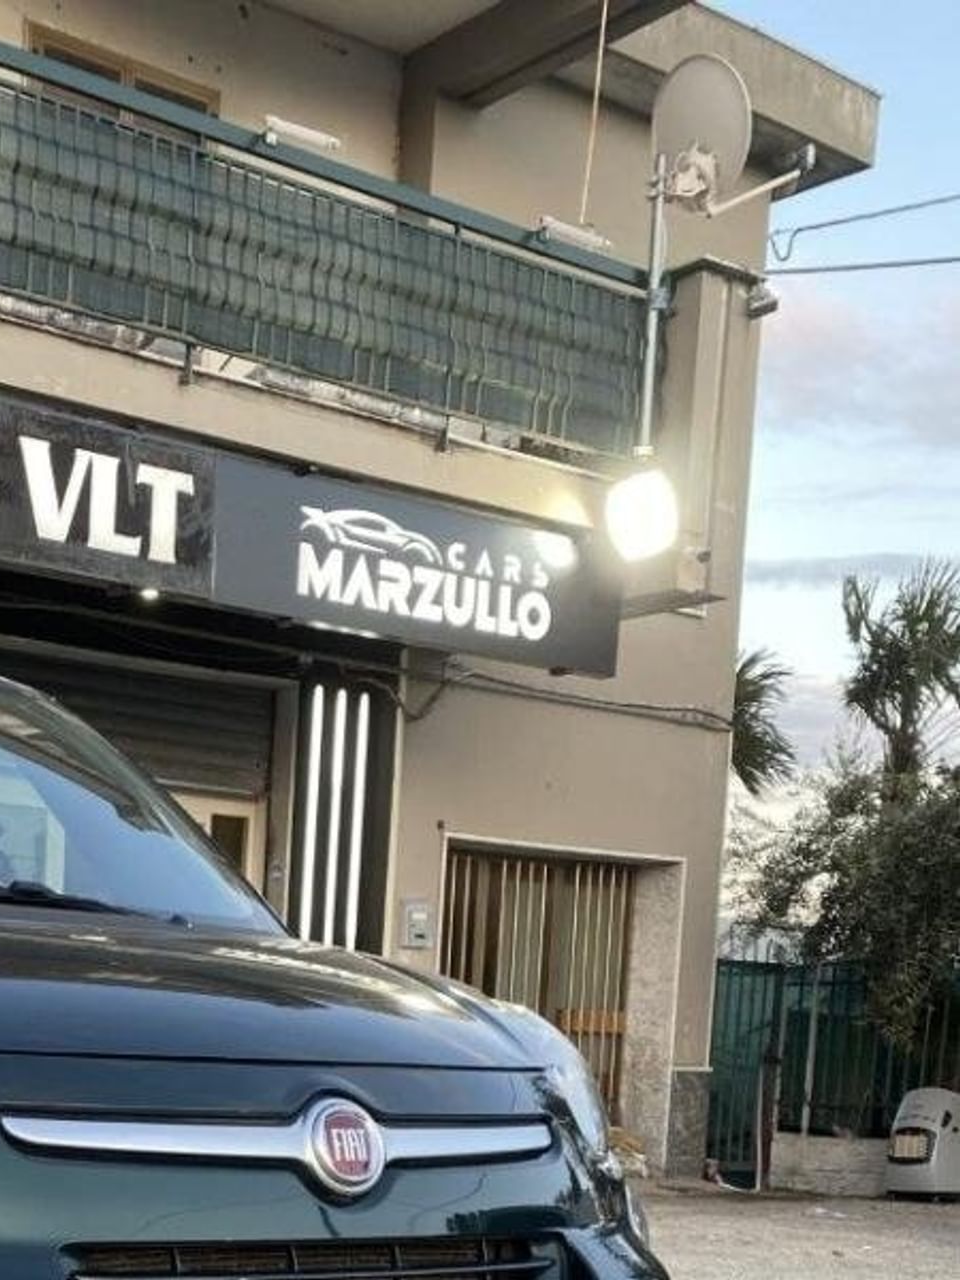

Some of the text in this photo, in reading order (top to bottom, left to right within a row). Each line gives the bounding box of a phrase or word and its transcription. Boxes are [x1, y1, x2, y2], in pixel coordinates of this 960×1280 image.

[18, 435, 194, 564] VLT
[297, 542, 552, 641] MARZULLO
[447, 541, 549, 588] CARS
[331, 1128, 368, 1162] FIAT
